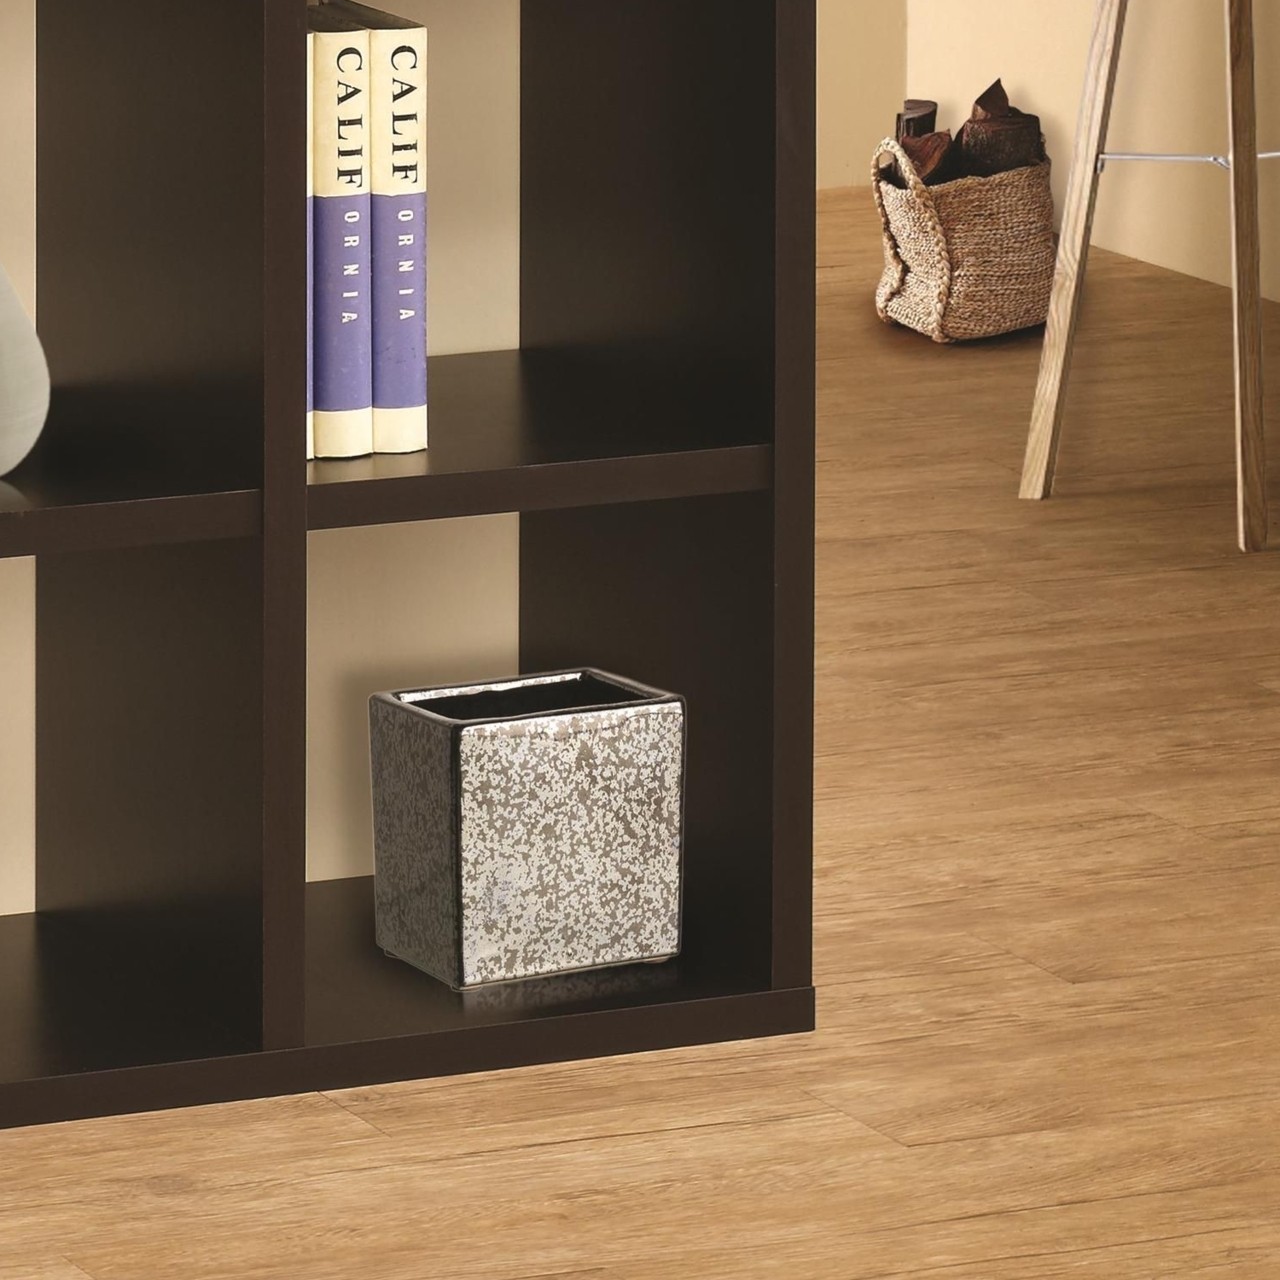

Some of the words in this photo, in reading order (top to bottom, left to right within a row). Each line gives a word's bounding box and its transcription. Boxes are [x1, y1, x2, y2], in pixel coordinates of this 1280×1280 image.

[336, 47, 363, 188] CALIF
[390, 45, 418, 183] CALIF
[341, 210, 360, 323] ORNIA
[397, 209, 416, 320] ORNIA
